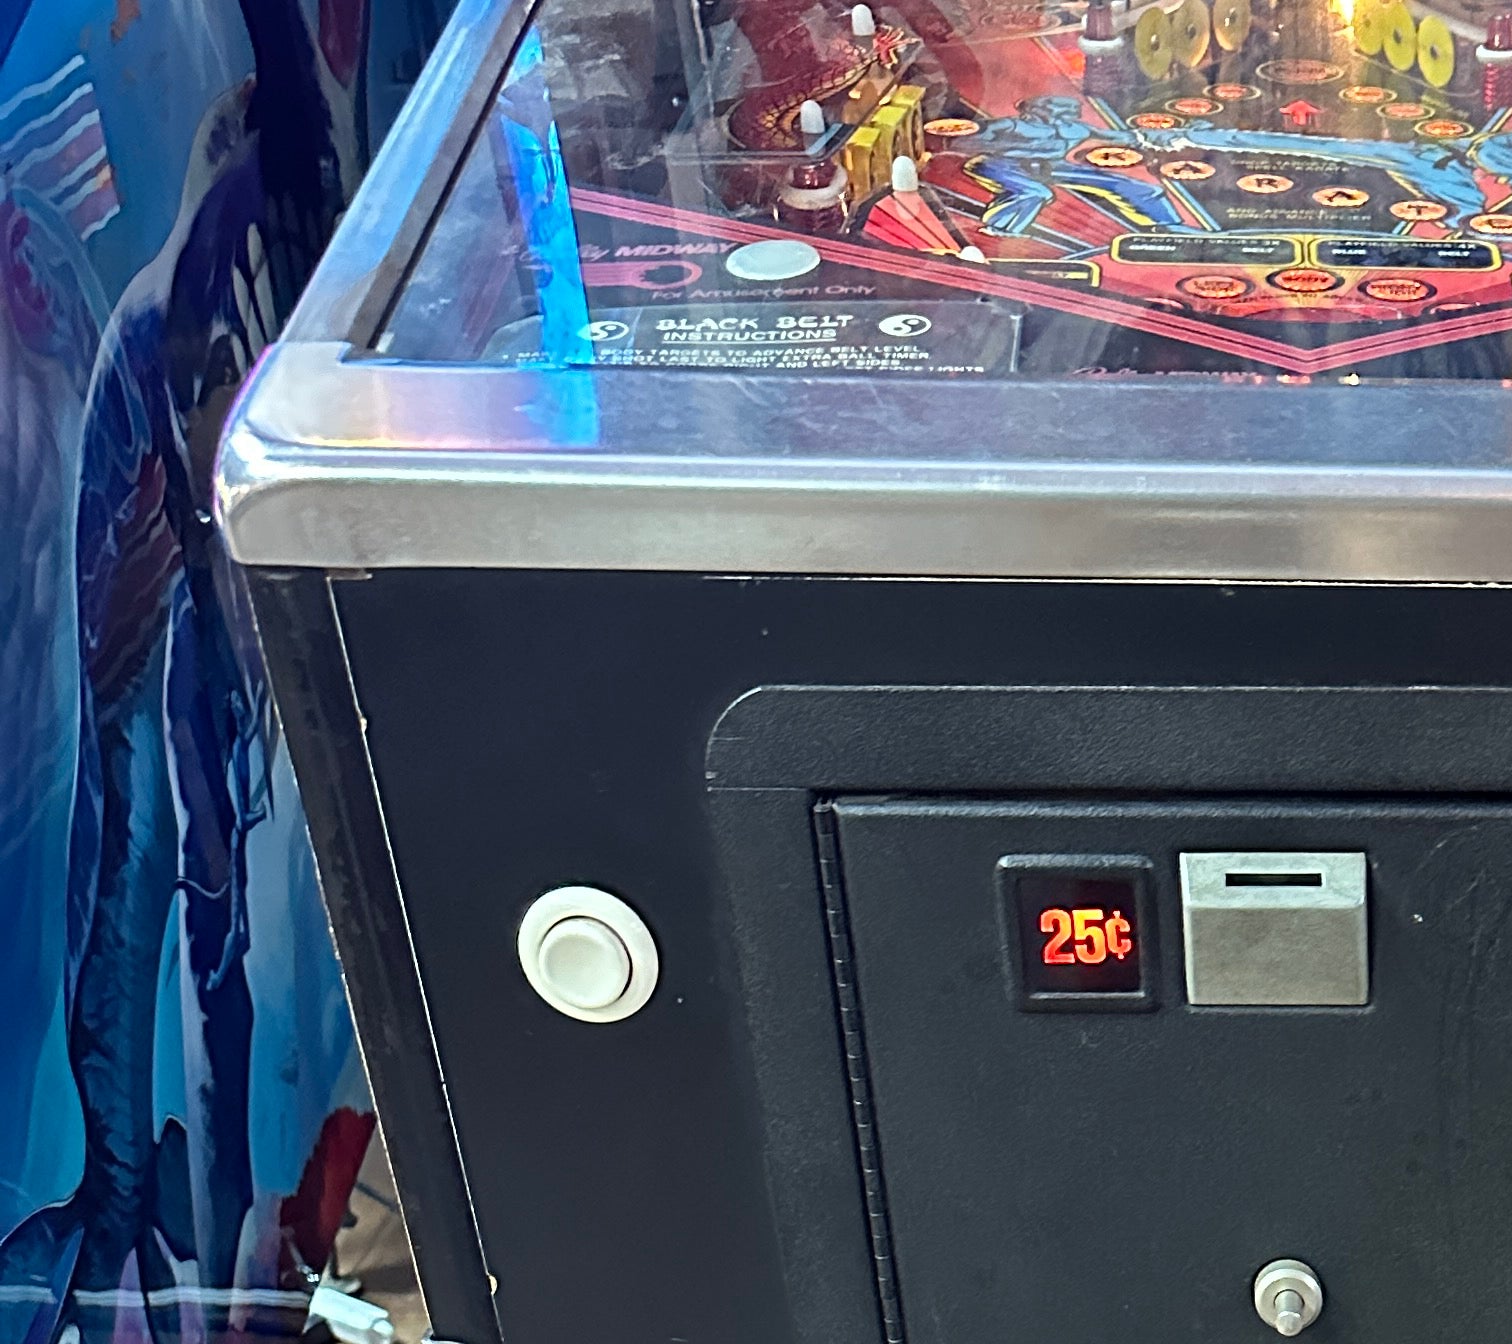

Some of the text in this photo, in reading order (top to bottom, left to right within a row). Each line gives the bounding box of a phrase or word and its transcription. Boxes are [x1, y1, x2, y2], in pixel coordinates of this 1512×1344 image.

[614, 243, 738, 257] MIDWAY
[824, 284, 877, 297] Only
[655, 314, 855, 331] BLACK BELT
[662, 329, 838, 342] INSTRUCTIONS
[705, 355, 728, 363] TO
[732, 355, 775, 363] LIGHT
[782, 353, 832, 362] EXTRA
[837, 352, 877, 361] BALL
[728, 349, 747, 357] TO
[750, 347, 826, 357] ADVANCE
[830, 346, 869, 354] BELT
[775, 360, 808, 369] AND
[1039, 908, 1133, 966] 25¢
